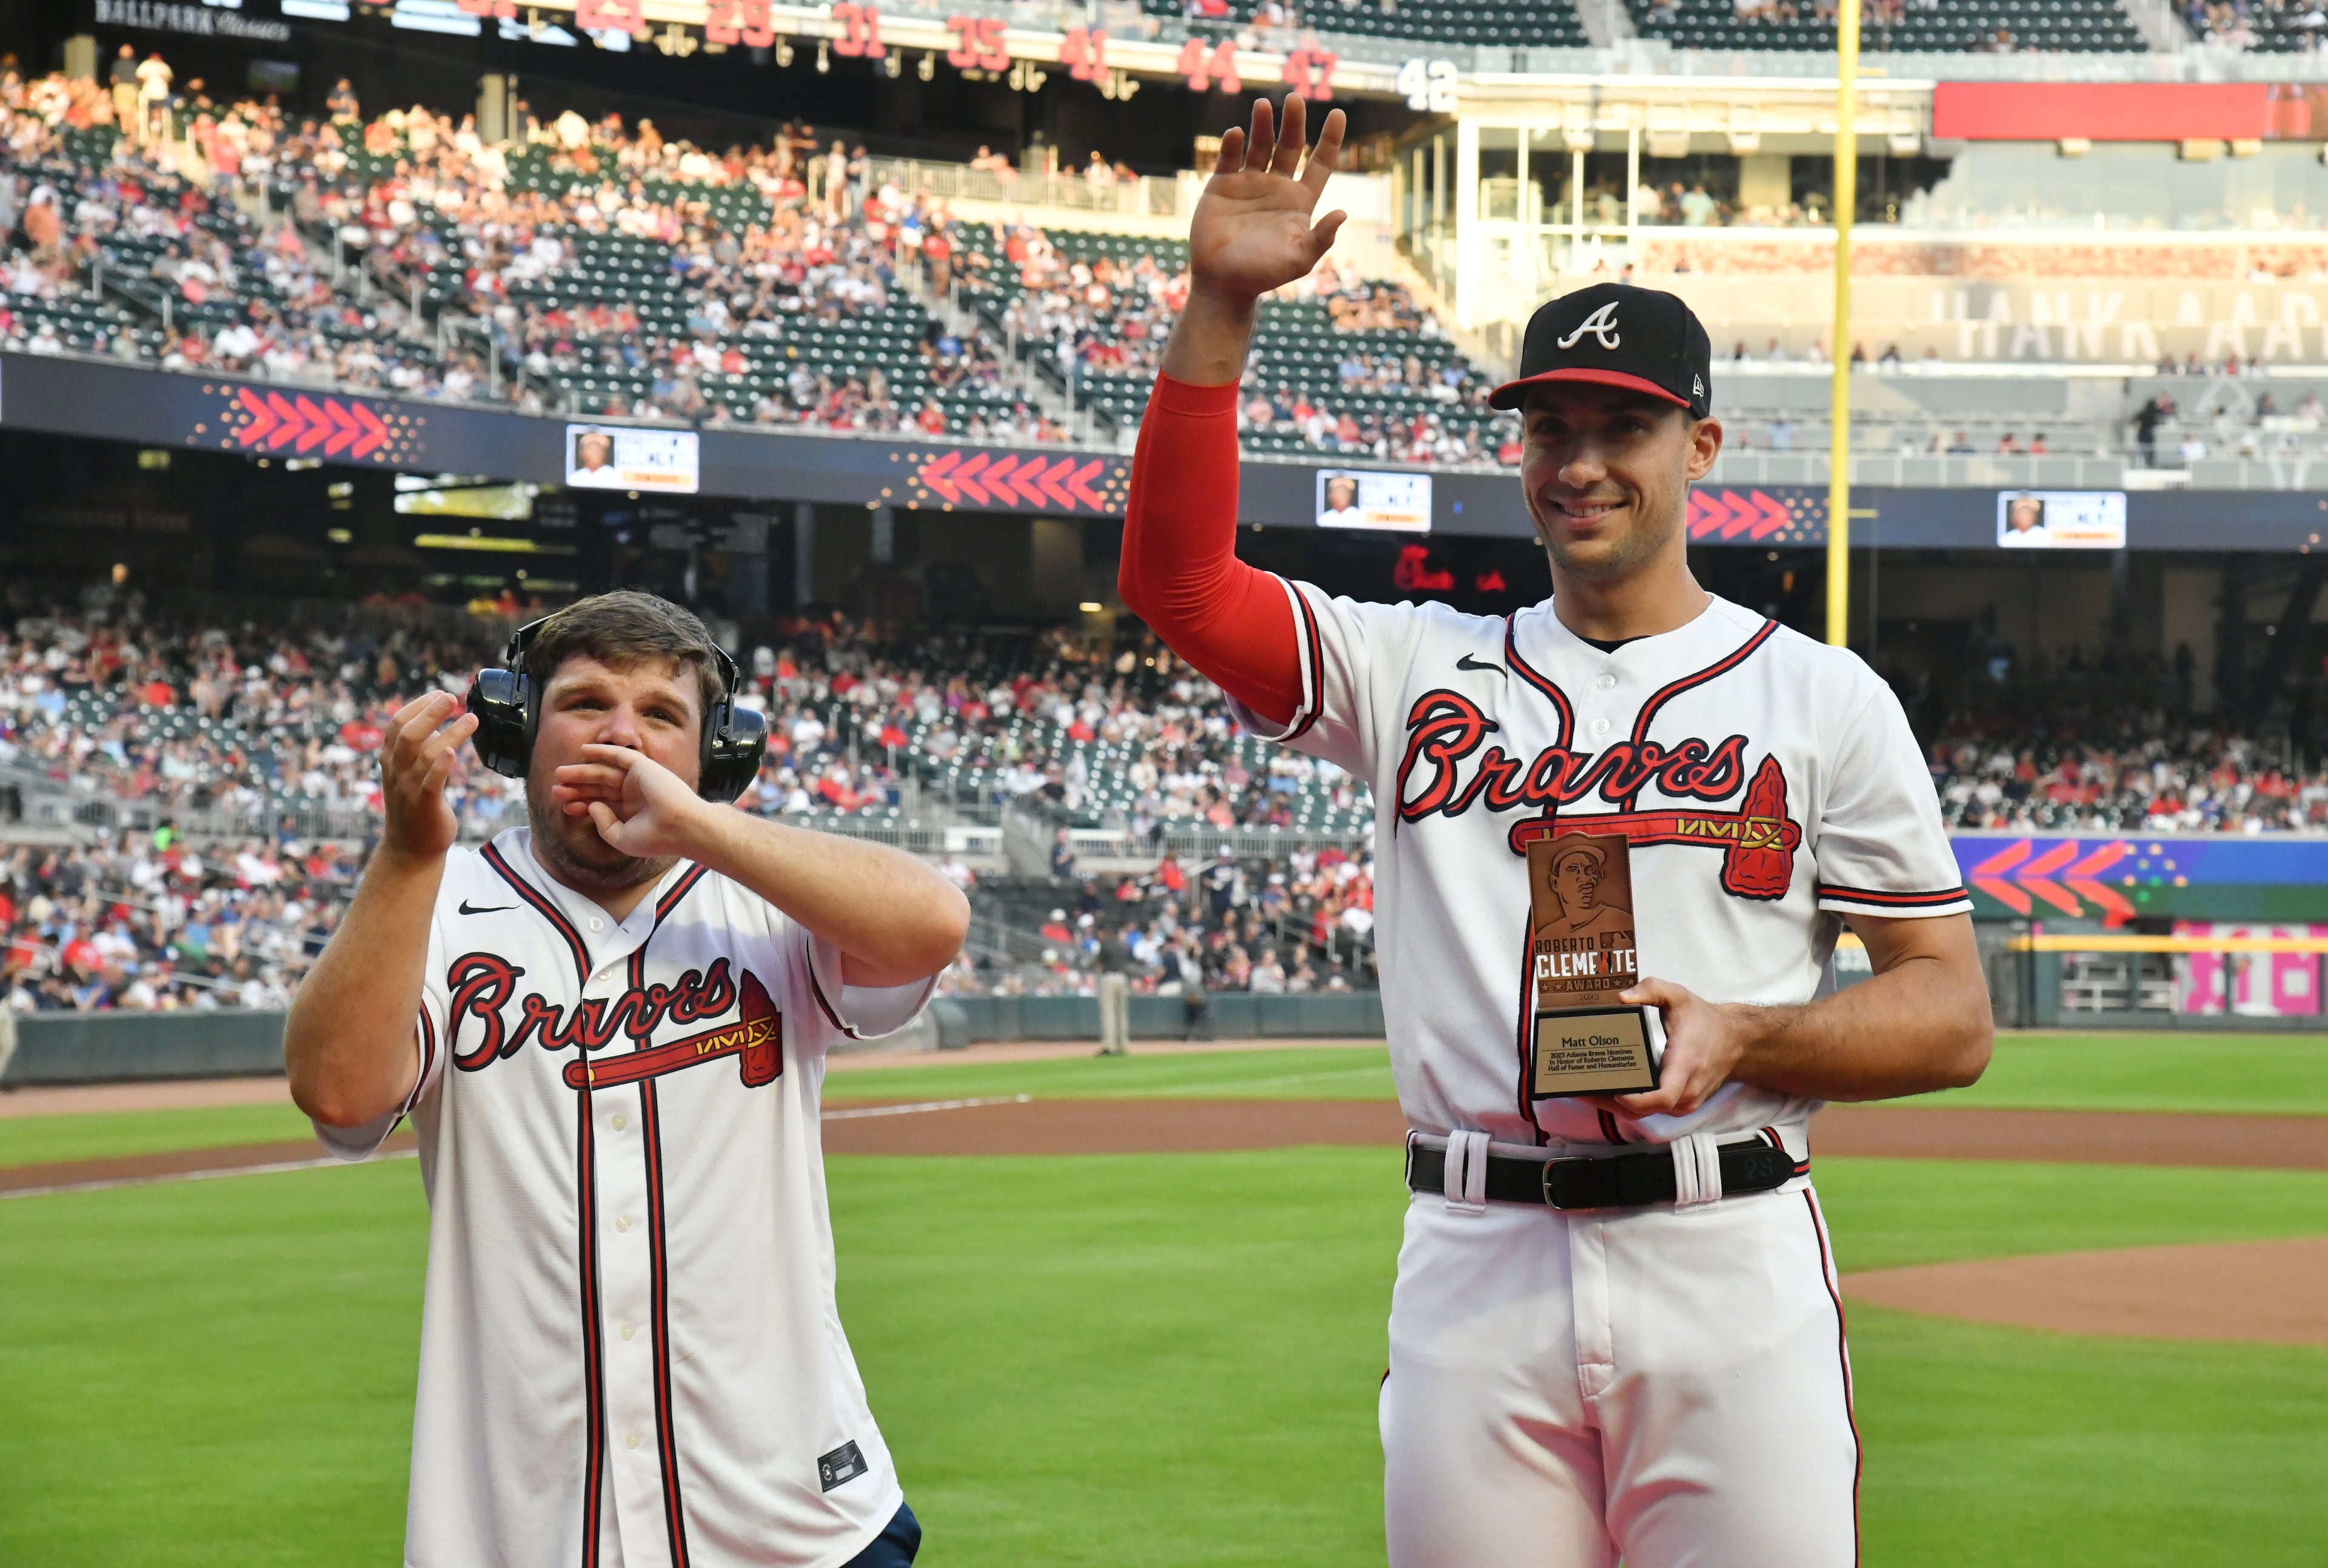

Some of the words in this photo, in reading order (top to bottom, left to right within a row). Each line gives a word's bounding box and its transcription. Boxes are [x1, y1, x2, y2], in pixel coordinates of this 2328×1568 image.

[705, 0, 774, 47] 29
[833, 2, 886, 58] 31
[947, 16, 1009, 72] 35
[1060, 28, 1109, 81] 41
[1177, 38, 1242, 94] 44
[1283, 50, 1337, 101] 47
[1397, 58, 1458, 112] 42
[1557, 301, 1621, 350] A
[1930, 290, 2162, 359] HANK
[1395, 689, 1749, 834] Braves
[1535, 937, 1594, 953] ROBERTO
[1566, 978, 1610, 992] AWARD
[1579, 993, 1599, 1002] 2023
[448, 952, 737, 1072] Braves
[1562, 1037, 1586, 1047] Matt
[1589, 1035, 1619, 1046] Olson
[1745, 1158, 1773, 1179] 28
